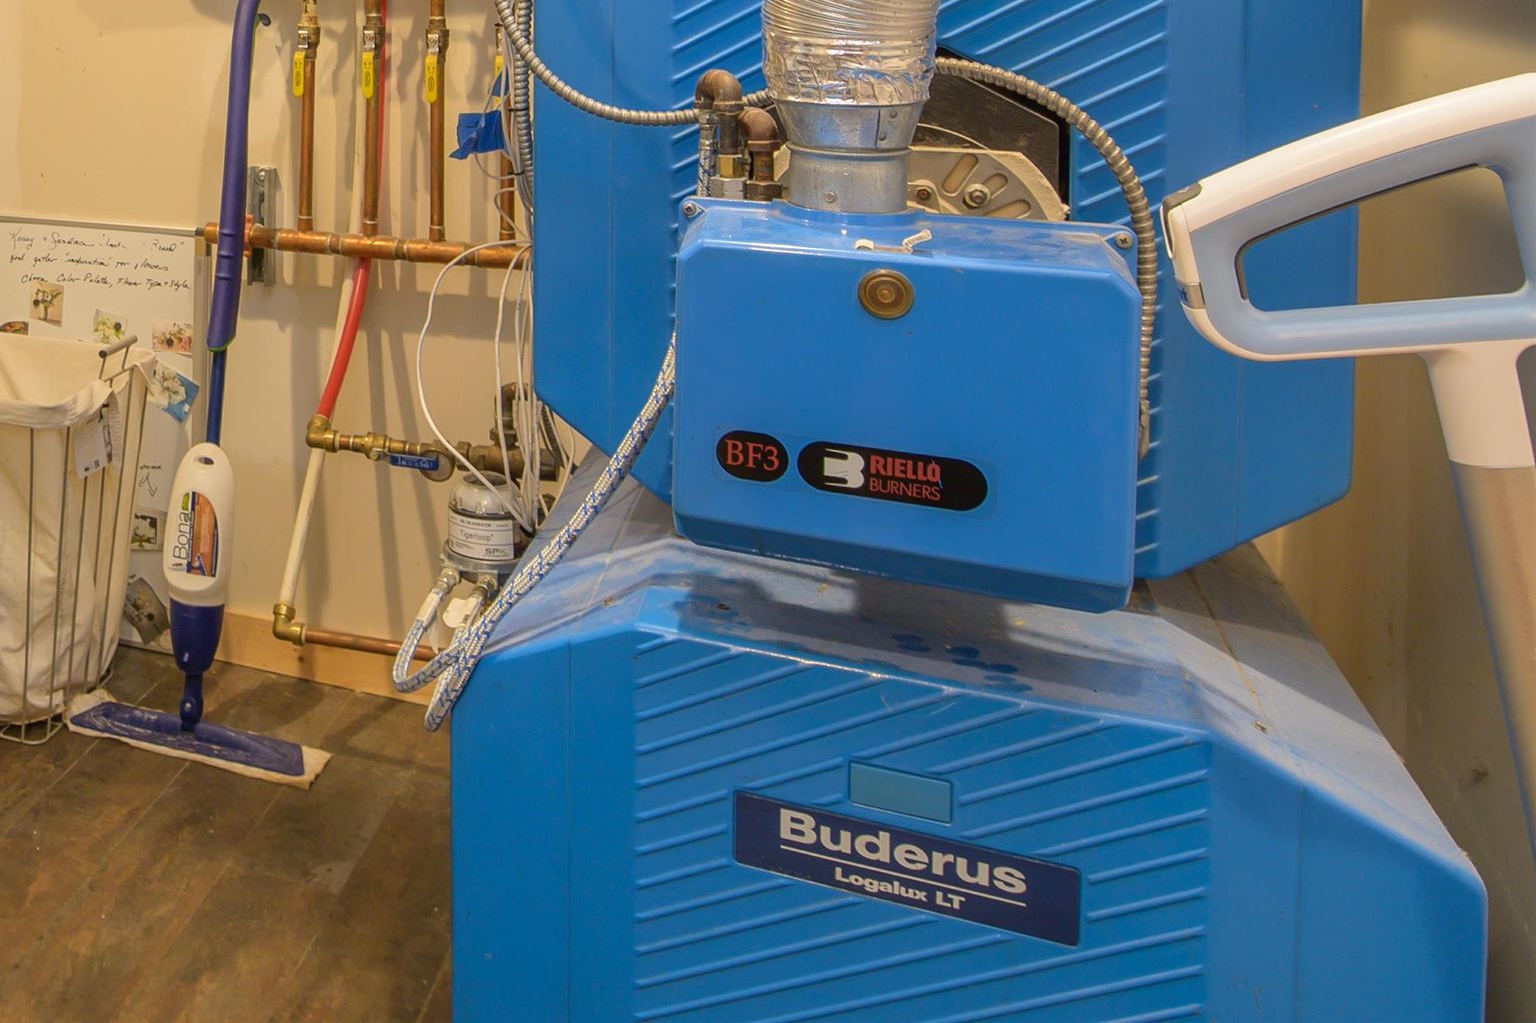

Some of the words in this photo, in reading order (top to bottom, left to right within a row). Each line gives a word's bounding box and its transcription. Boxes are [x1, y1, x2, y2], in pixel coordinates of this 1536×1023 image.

[56, 272, 81, 283] Color
[725, 439, 781, 473] BF3
[869, 454, 941, 483] RIELLO
[869, 479, 941, 502] BURNERS
[172, 511, 191, 560] Bona
[778, 807, 1028, 896] Buderus
[835, 866, 927, 903] Logalux
[935, 891, 966, 911] LT
